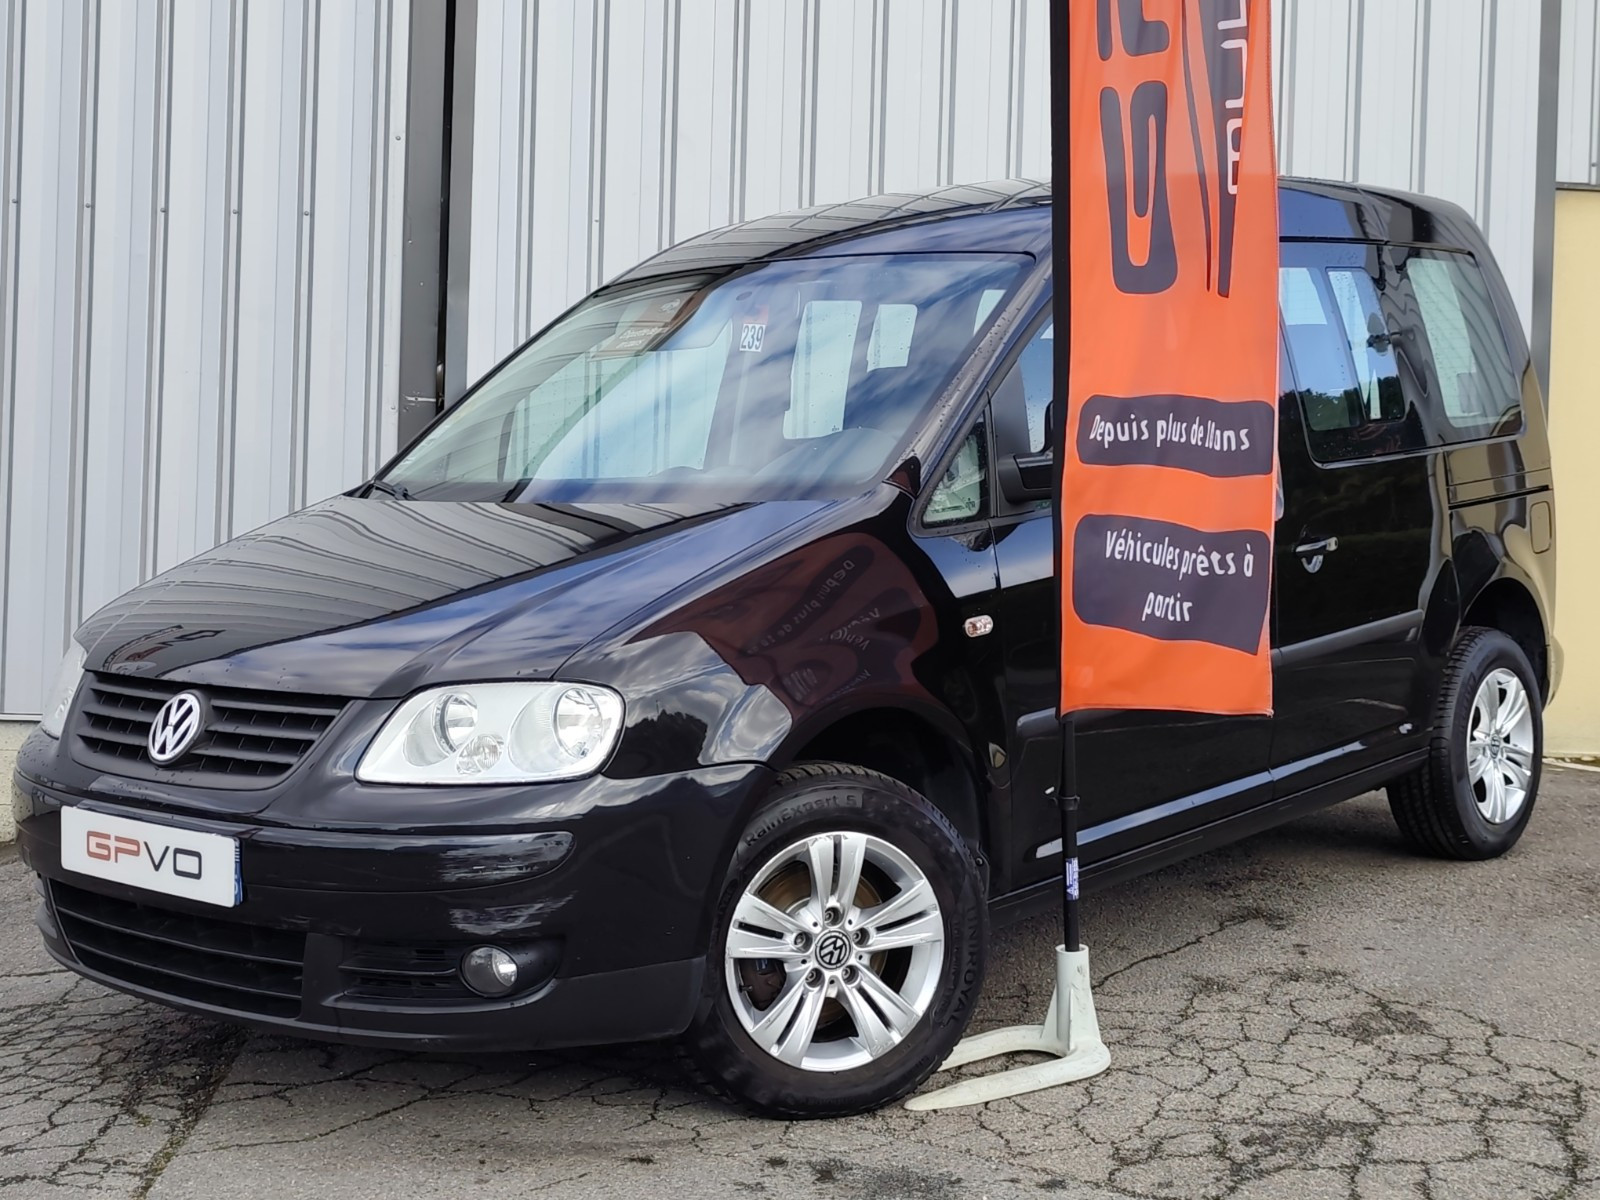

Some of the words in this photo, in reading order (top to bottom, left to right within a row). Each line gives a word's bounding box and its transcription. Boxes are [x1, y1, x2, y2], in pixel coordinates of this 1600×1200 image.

[741, 324, 764, 350] 239
[1089, 414, 1149, 448] Depuis
[1156, 413, 1187, 447] plus
[1190, 416, 1204, 446] de
[1105, 528, 1180, 571] Véhicules
[1178, 545, 1236, 580] prêts
[1243, 543, 1254, 577] à
[1142, 592, 1193, 622] partir
[86, 830, 202, 880] GPVO
